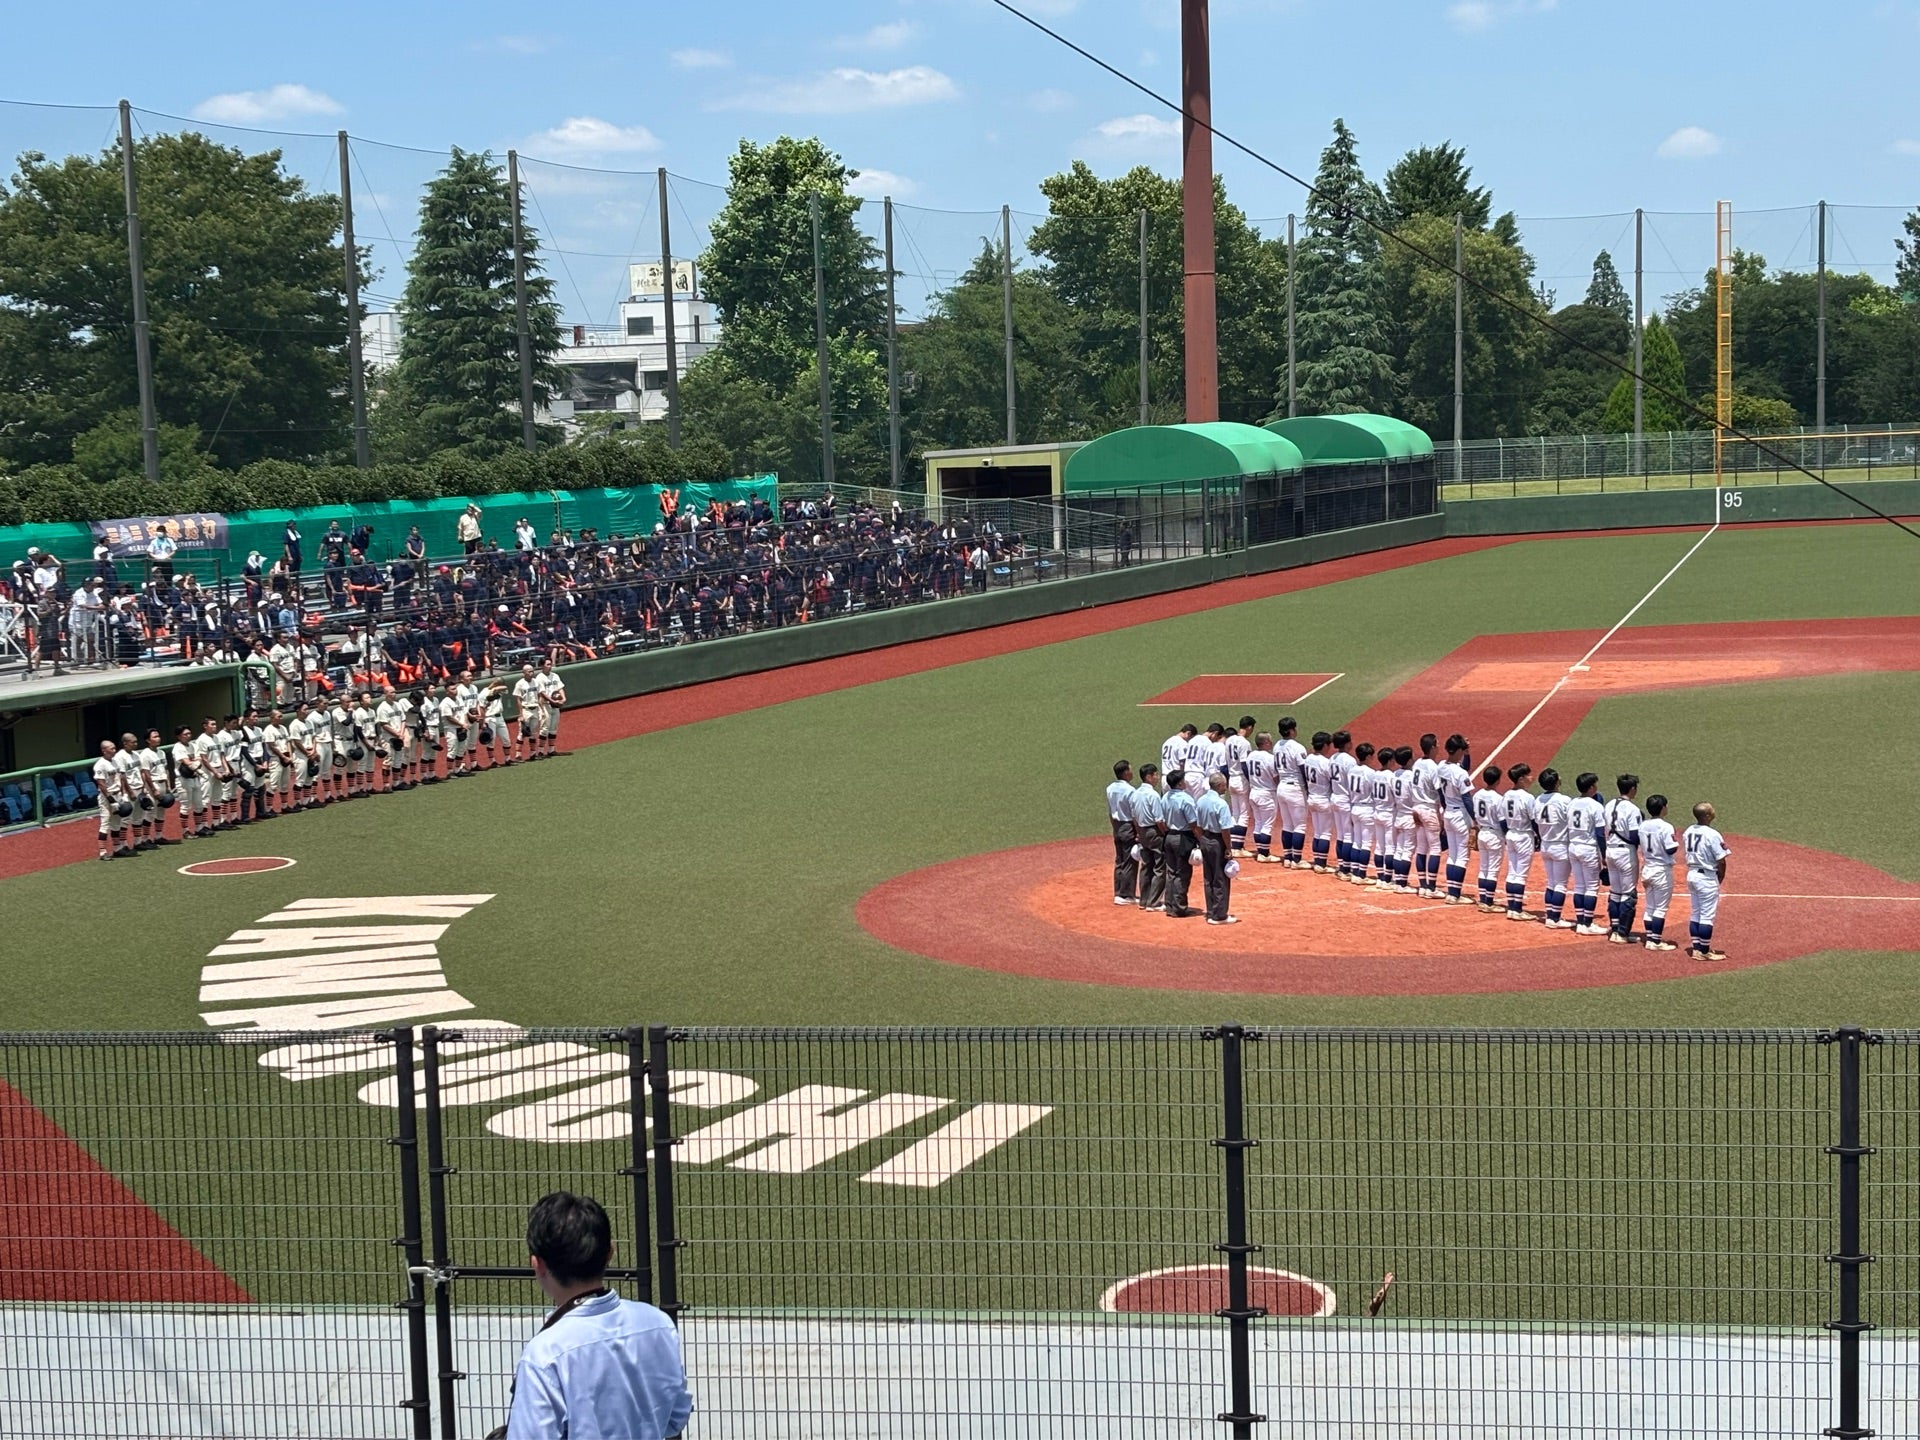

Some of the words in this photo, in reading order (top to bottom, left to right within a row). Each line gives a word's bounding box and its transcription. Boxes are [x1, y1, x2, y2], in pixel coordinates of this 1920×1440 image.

[1724, 491, 1743, 508] 95
[1249, 759, 1261, 777] 15
[1413, 769, 1421, 785] 8
[1350, 775, 1361, 793] 11
[1374, 781, 1386, 800] 10
[1395, 779, 1402, 796] 9
[1478, 800, 1486, 818] 6
[1507, 799, 1515, 818] 5
[1541, 805, 1550, 823] 4
[1573, 810, 1582, 828] 3
[1646, 833, 1653, 853] 1
[1687, 833, 1702, 853] 17
[199, 893, 1054, 1188] KAWAGUCHI
